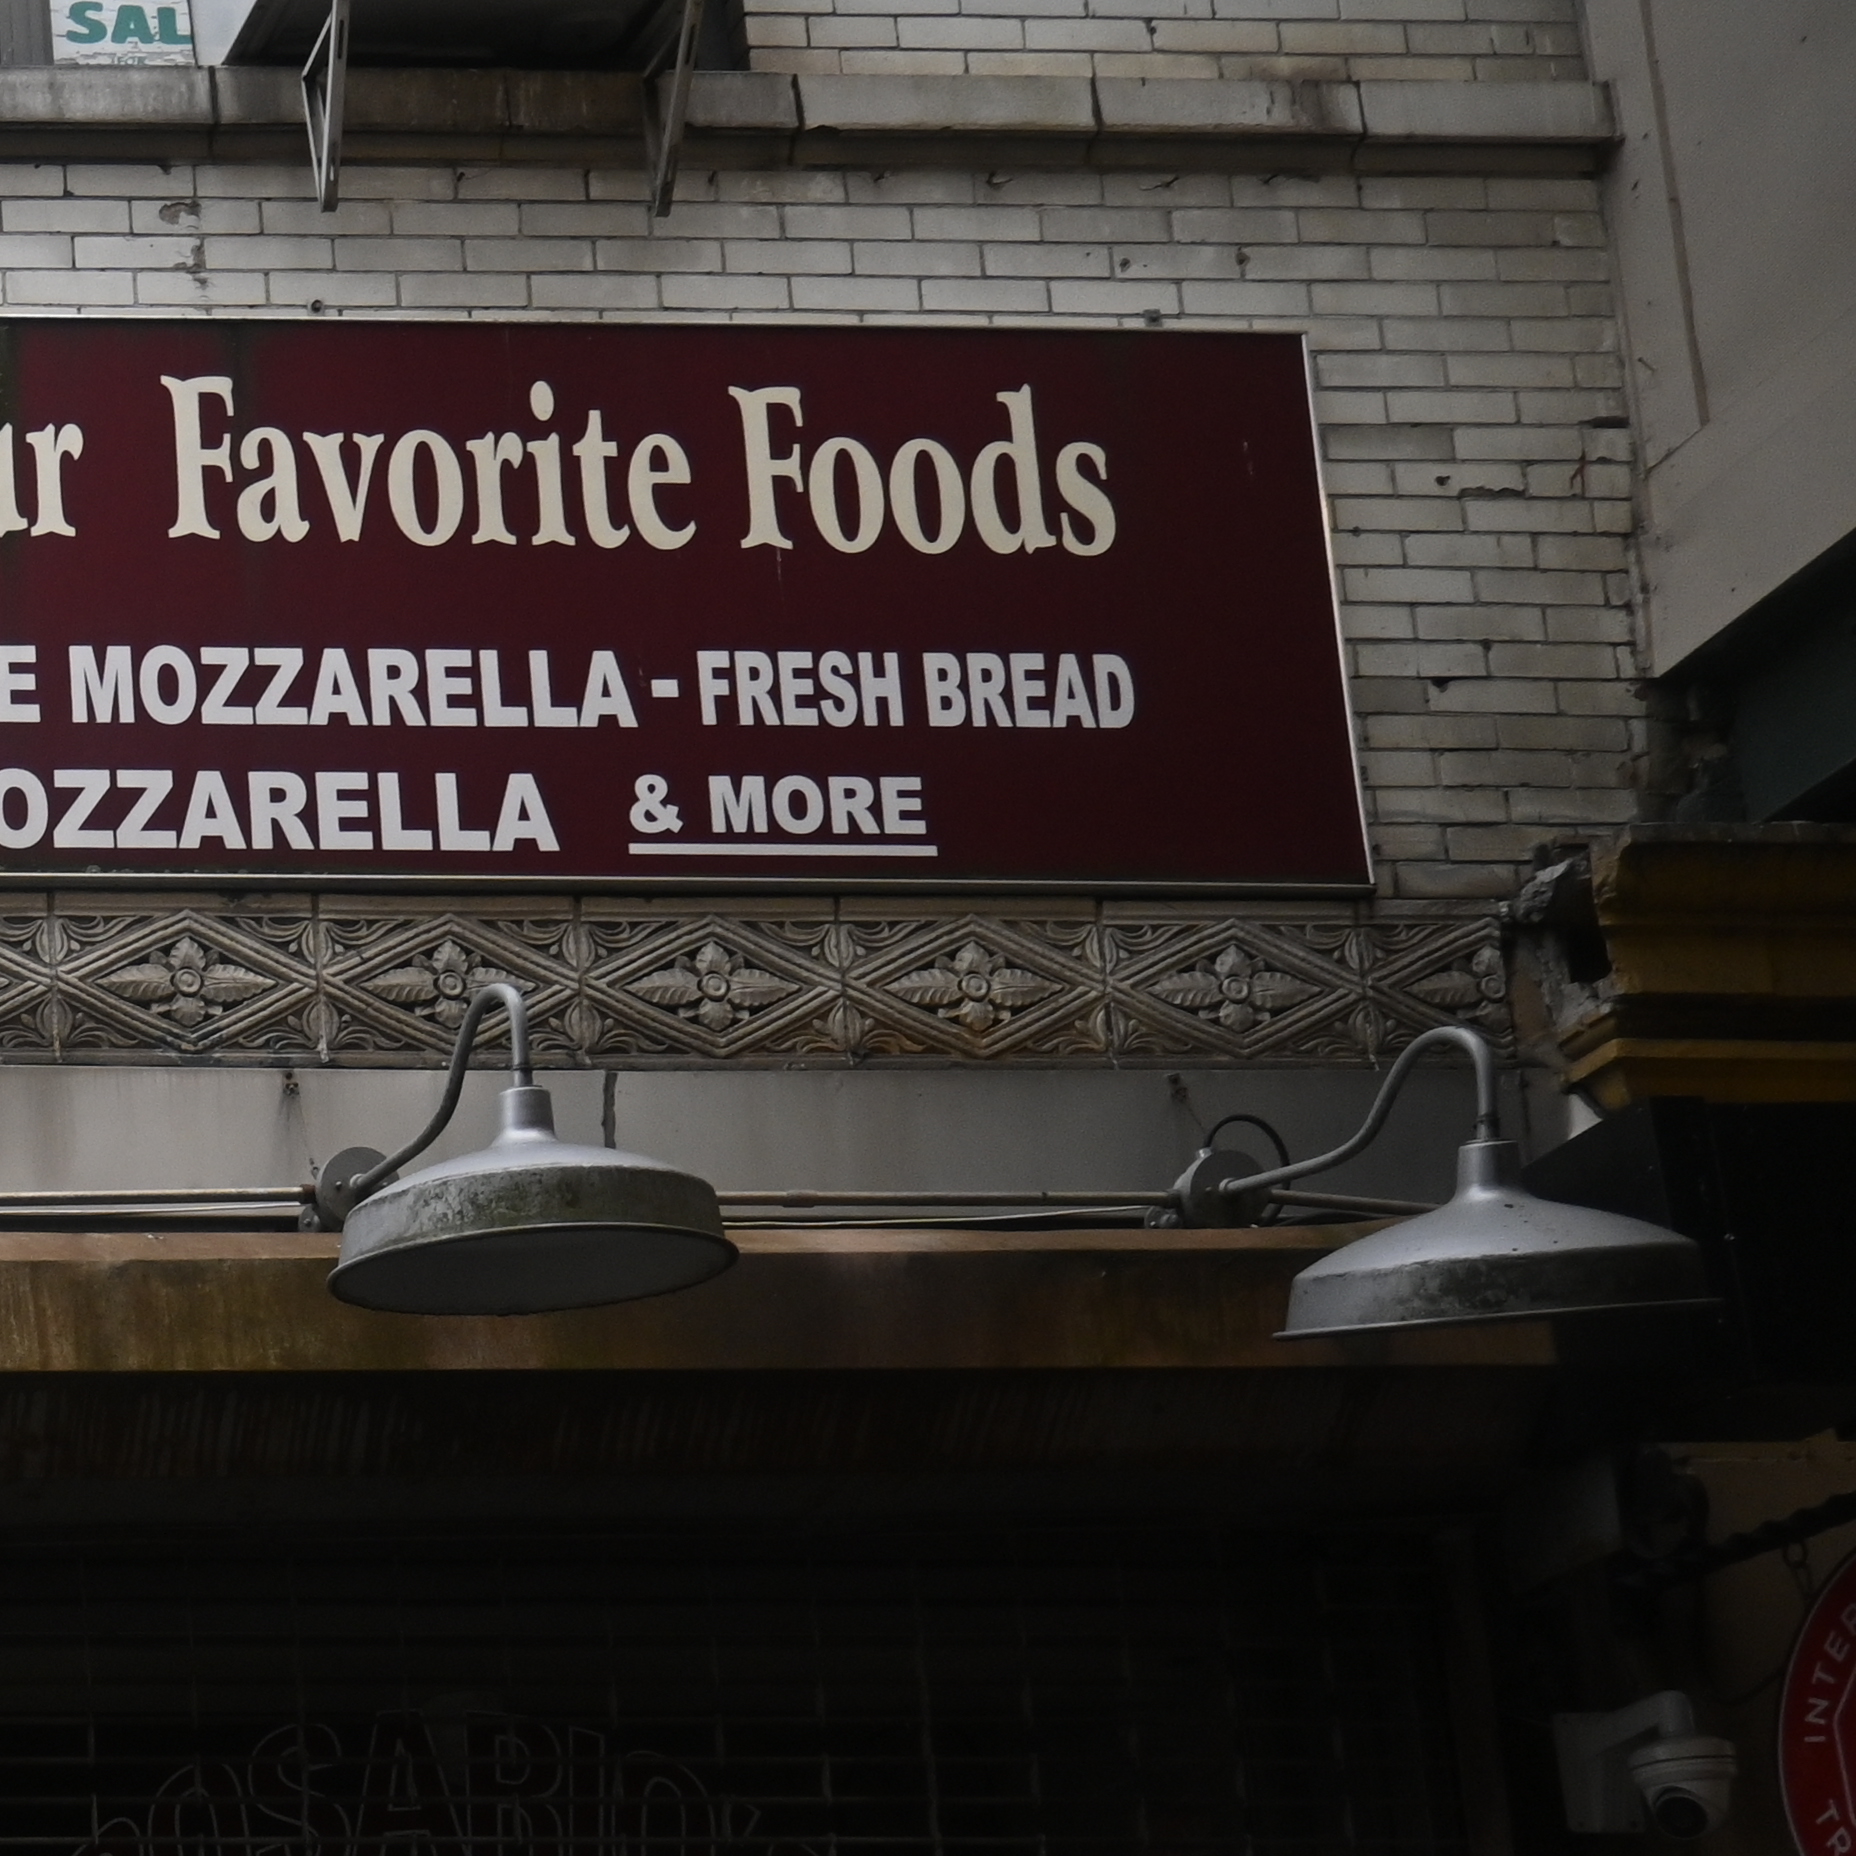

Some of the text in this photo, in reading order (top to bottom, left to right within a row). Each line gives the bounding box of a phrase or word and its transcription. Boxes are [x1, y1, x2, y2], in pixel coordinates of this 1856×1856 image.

[161, 375, 695, 549] Favorite
[729, 384, 1115, 555] Foods
[69, 645, 638, 727] MOZZARELLA
[697, 651, 903, 727] FRESH
[923, 653, 1133, 727] BREAD
[630, 775, 682, 833] &
[709, 776, 926, 834] MORE
